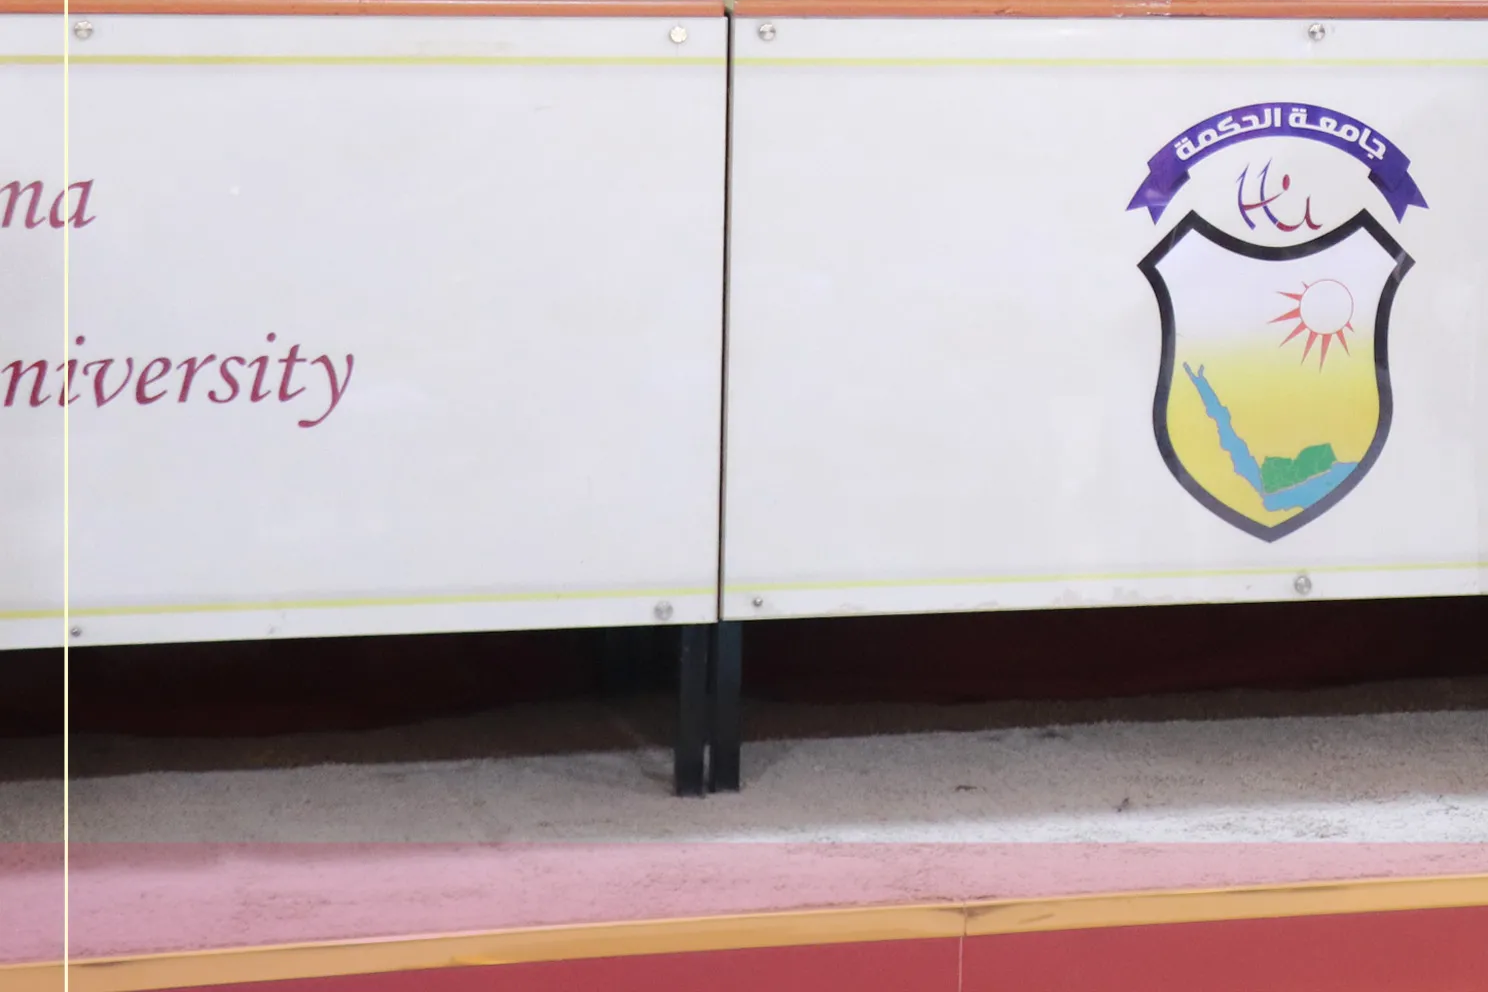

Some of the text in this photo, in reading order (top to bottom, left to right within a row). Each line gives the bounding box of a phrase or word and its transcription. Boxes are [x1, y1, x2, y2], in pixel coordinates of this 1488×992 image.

[1174, 107, 1387, 161] جامعة الحكمة
[0, 331, 355, 429] niversity
